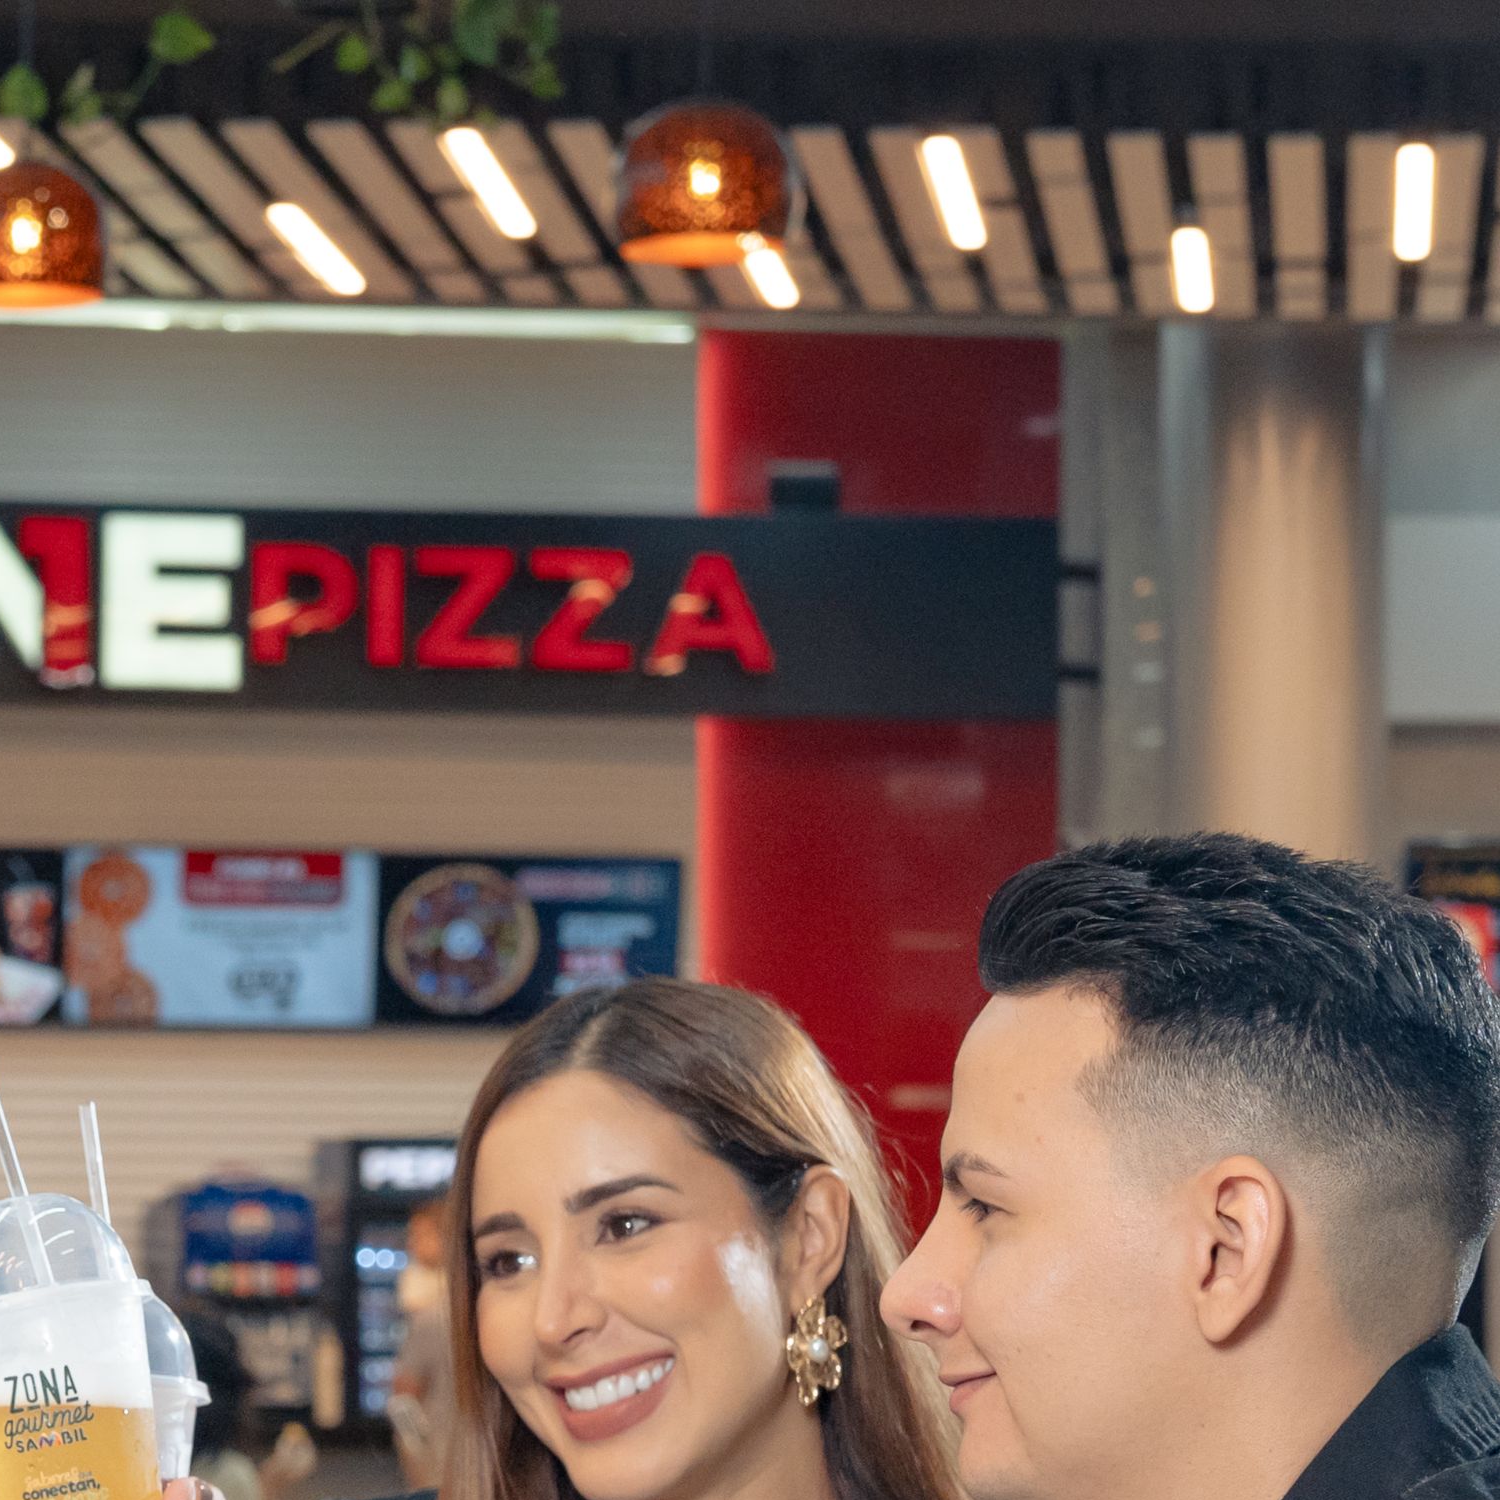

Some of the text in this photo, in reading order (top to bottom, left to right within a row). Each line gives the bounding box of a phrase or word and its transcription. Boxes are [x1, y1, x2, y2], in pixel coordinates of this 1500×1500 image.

[249, 541, 775, 674] PIZZA
[3, 1364, 79, 1414] ZONA
[4, 1400, 95, 1449] gourmet
[15, 1428, 88, 1453] SAMBIL
